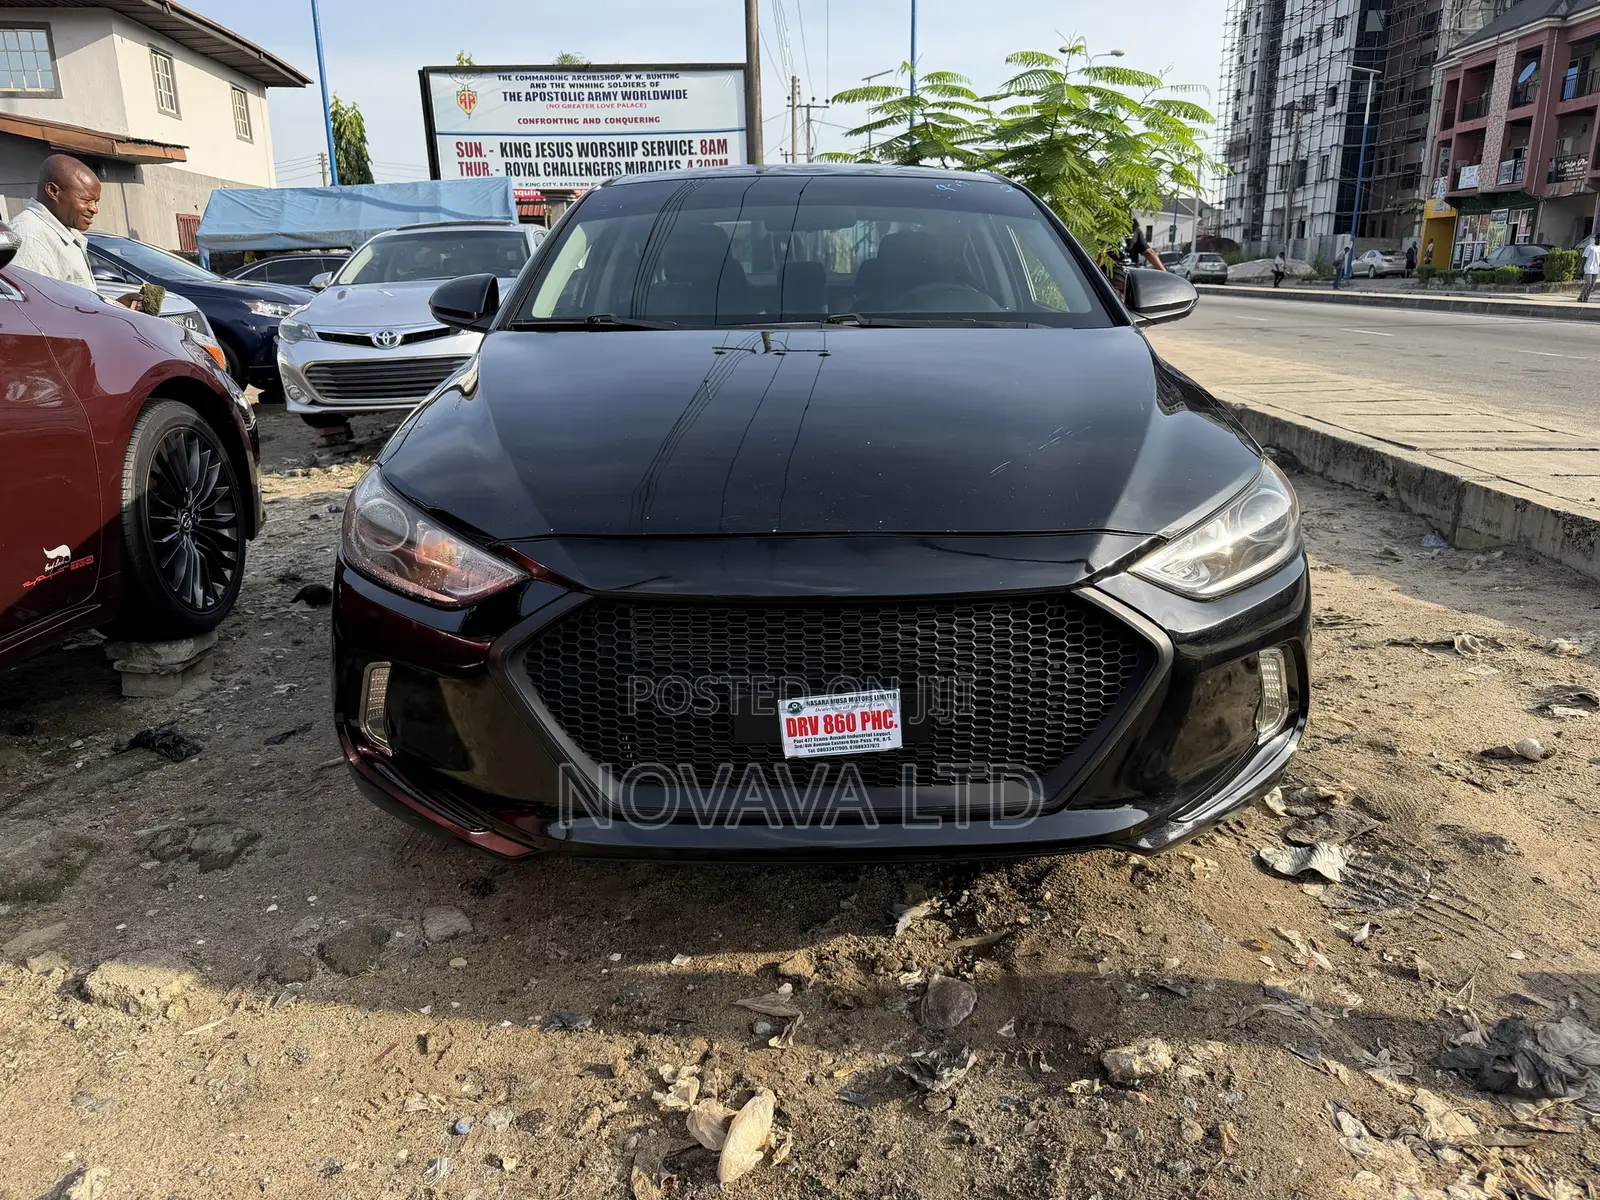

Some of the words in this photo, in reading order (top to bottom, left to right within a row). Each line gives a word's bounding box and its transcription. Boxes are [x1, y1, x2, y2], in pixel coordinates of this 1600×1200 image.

[502, 91, 523, 102] THE
[525, 91, 585, 102] APOSTOLIC
[588, 91, 618, 102] ARMY
[621, 89, 688, 100] WORLDWIDE
[517, 117, 579, 125] CONFRONTING
[583, 117, 601, 125] AND
[604, 116, 661, 125] CONQUERING
[455, 141, 487, 158] SUN.
[500, 142, 531, 158] KING
[535, 141, 573, 158] JESUS
[576, 141, 638, 158] WORSHIP
[641, 140, 697, 157] SERVICE.
[700, 138, 728, 155] 8AM
[457, 161, 493, 177] THUR.
[504, 161, 541, 177] ROYAL
[543, 161, 622, 177] CHALLENGERS
[848, 695, 873, 704] MOTORS
[874, 692, 897, 701] LIMITED
[785, 715, 819, 737] DRV
[823, 712, 857, 735] 860
[860, 709, 898, 732] PHC.
